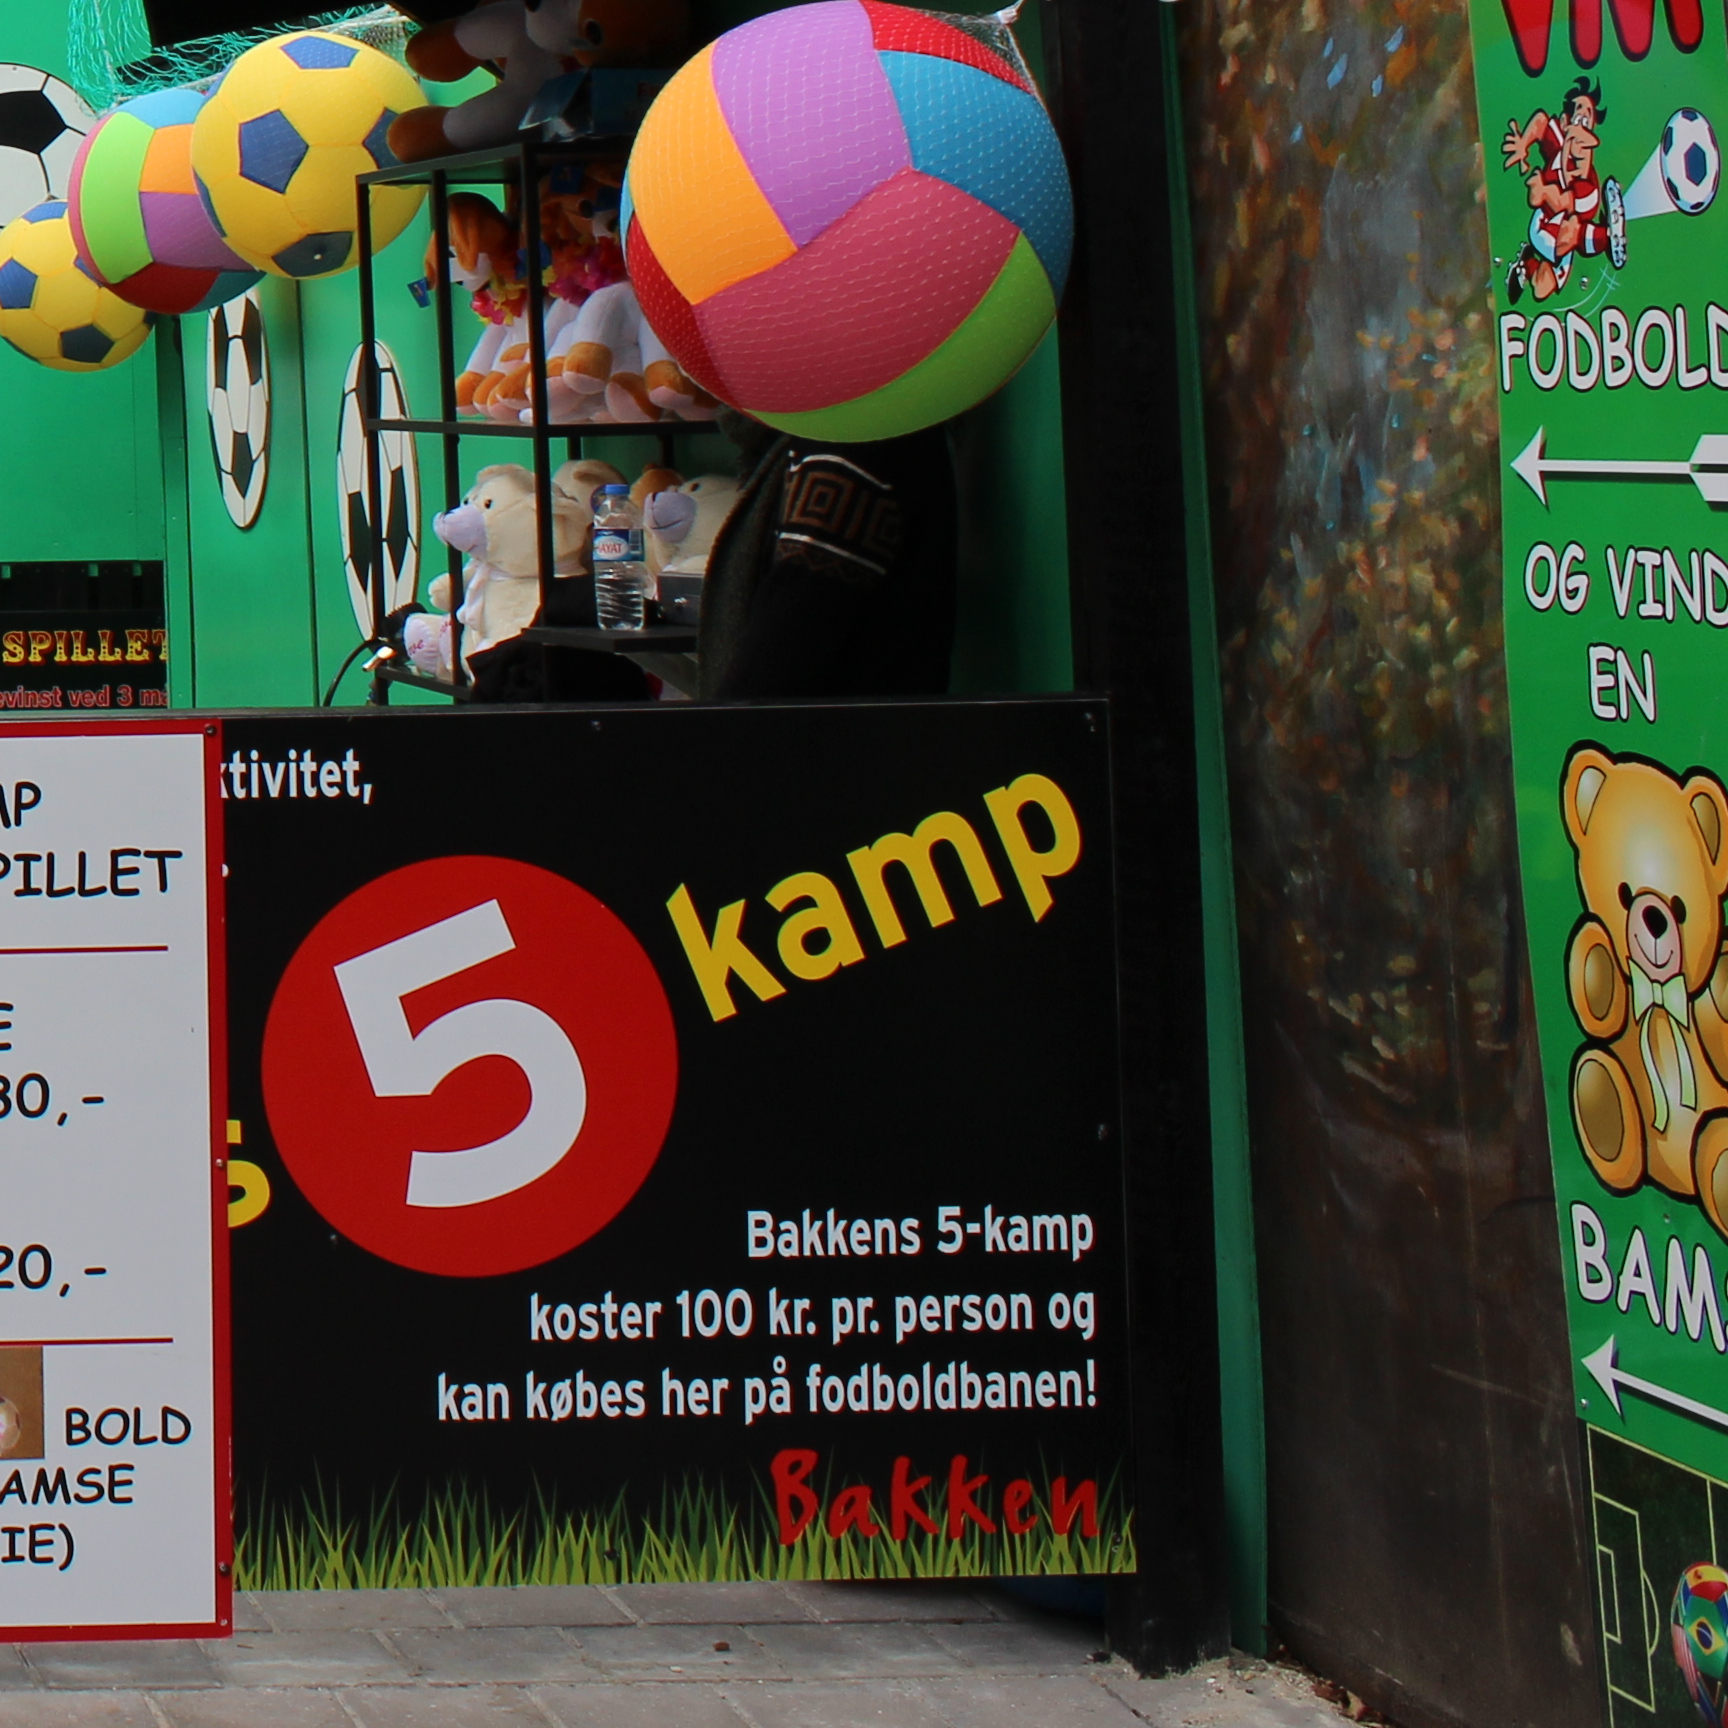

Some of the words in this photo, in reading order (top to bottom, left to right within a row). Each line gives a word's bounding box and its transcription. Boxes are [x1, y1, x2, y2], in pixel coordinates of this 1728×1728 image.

[1524, 540, 1589, 614] OG
[68, 685, 111, 708] ved
[117, 685, 134, 707] 3
[1588, 642, 1657, 723] EN
[665, 772, 1083, 1023] kamp
[333, 898, 587, 1208] 5
[748, 1207, 921, 1258] Bakkens
[937, 1205, 1095, 1262] 5-kamp
[1570, 1200, 1728, 1355] BAM
[530, 1291, 661, 1342] koster
[676, 1288, 753, 1339] 100
[770, 1288, 817, 1337] kr.
[832, 1300, 881, 1345] pr.
[895, 1292, 1034, 1342] person
[1047, 1291, 1097, 1341] og
[65, 1406, 193, 1447] BOLD
[438, 1371, 510, 1421] kan
[526, 1367, 646, 1421] købes
[661, 1365, 728, 1416] her
[744, 1355, 792, 1425] på
[806, 1358, 1098, 1414] fodboldbanen!
[770, 1446, 1098, 1545] Bakken
